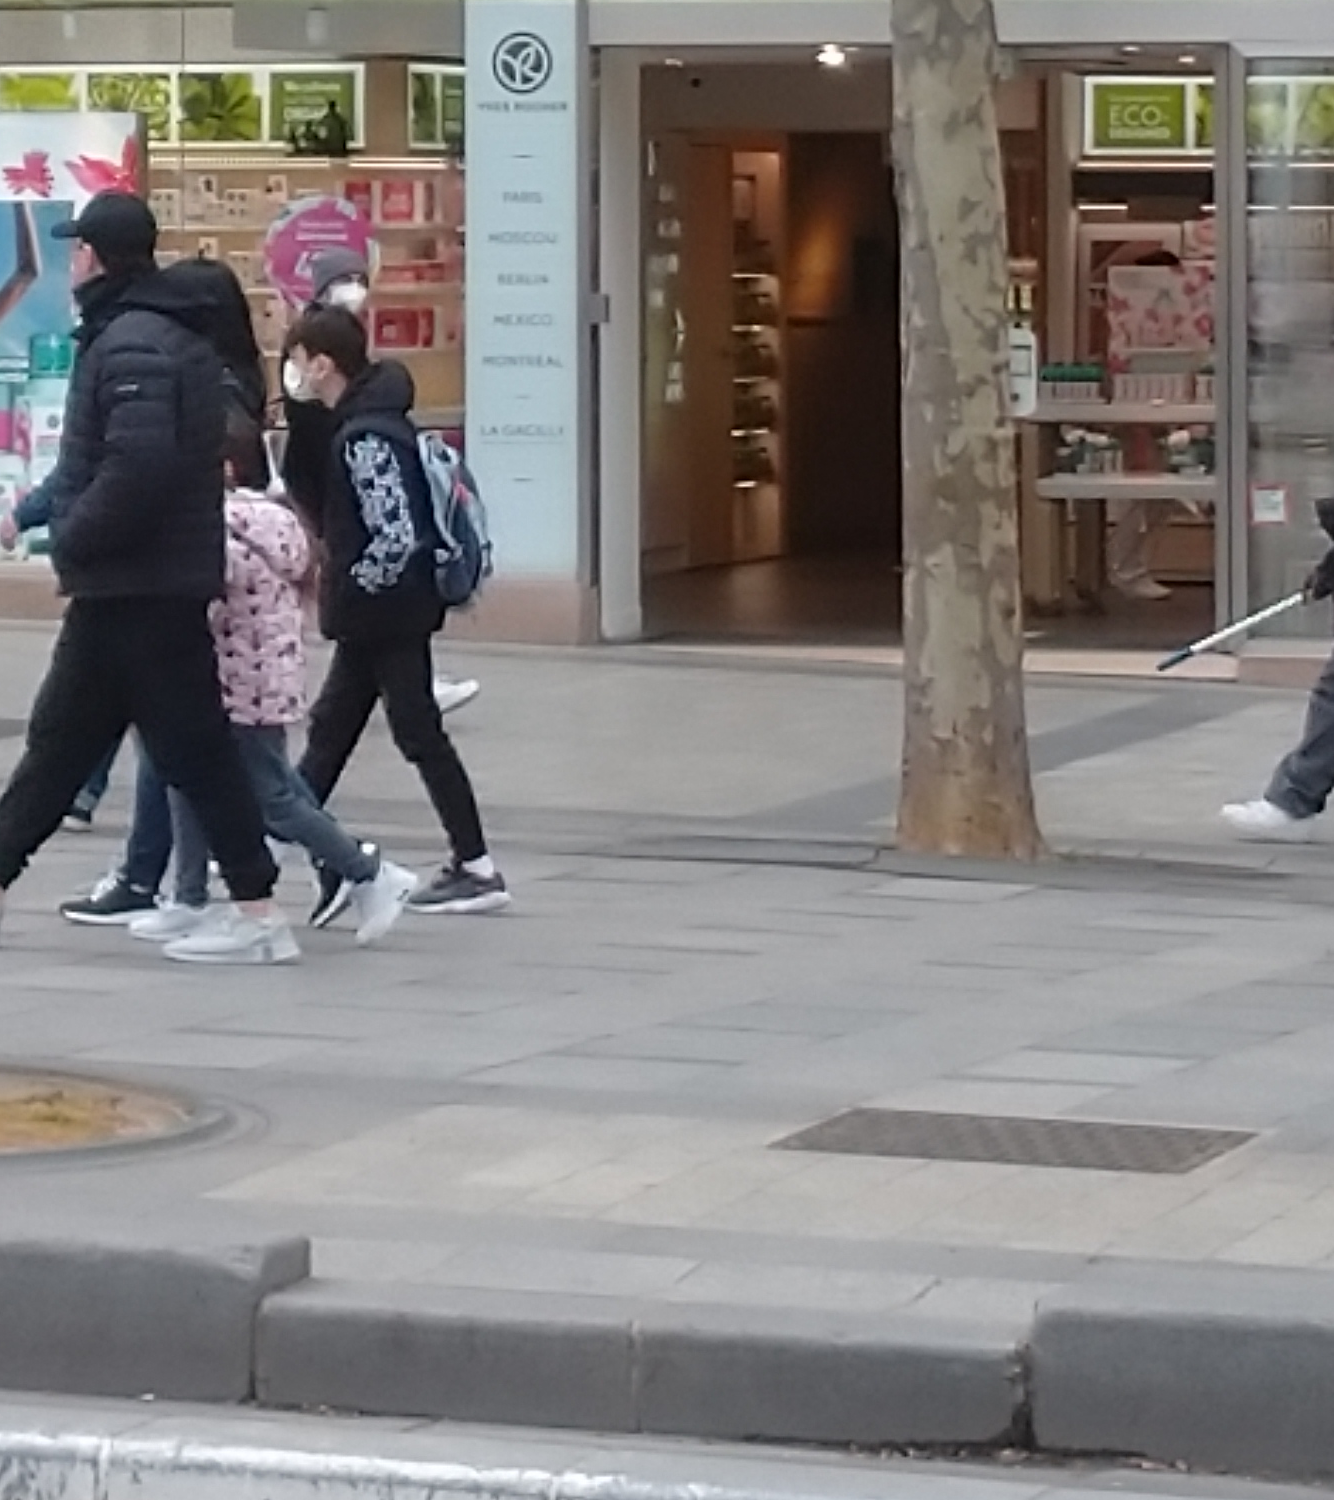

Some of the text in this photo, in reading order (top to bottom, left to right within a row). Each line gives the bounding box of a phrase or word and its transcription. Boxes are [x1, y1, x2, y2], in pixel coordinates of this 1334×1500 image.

[476, 101, 509, 112] YVES
[502, 191, 543, 204] PARIS
[487, 231, 558, 244] MOSCOU
[496, 273, 549, 286] BERLIN
[492, 313, 553, 326] MEXICO
[479, 424, 499, 436] LA
